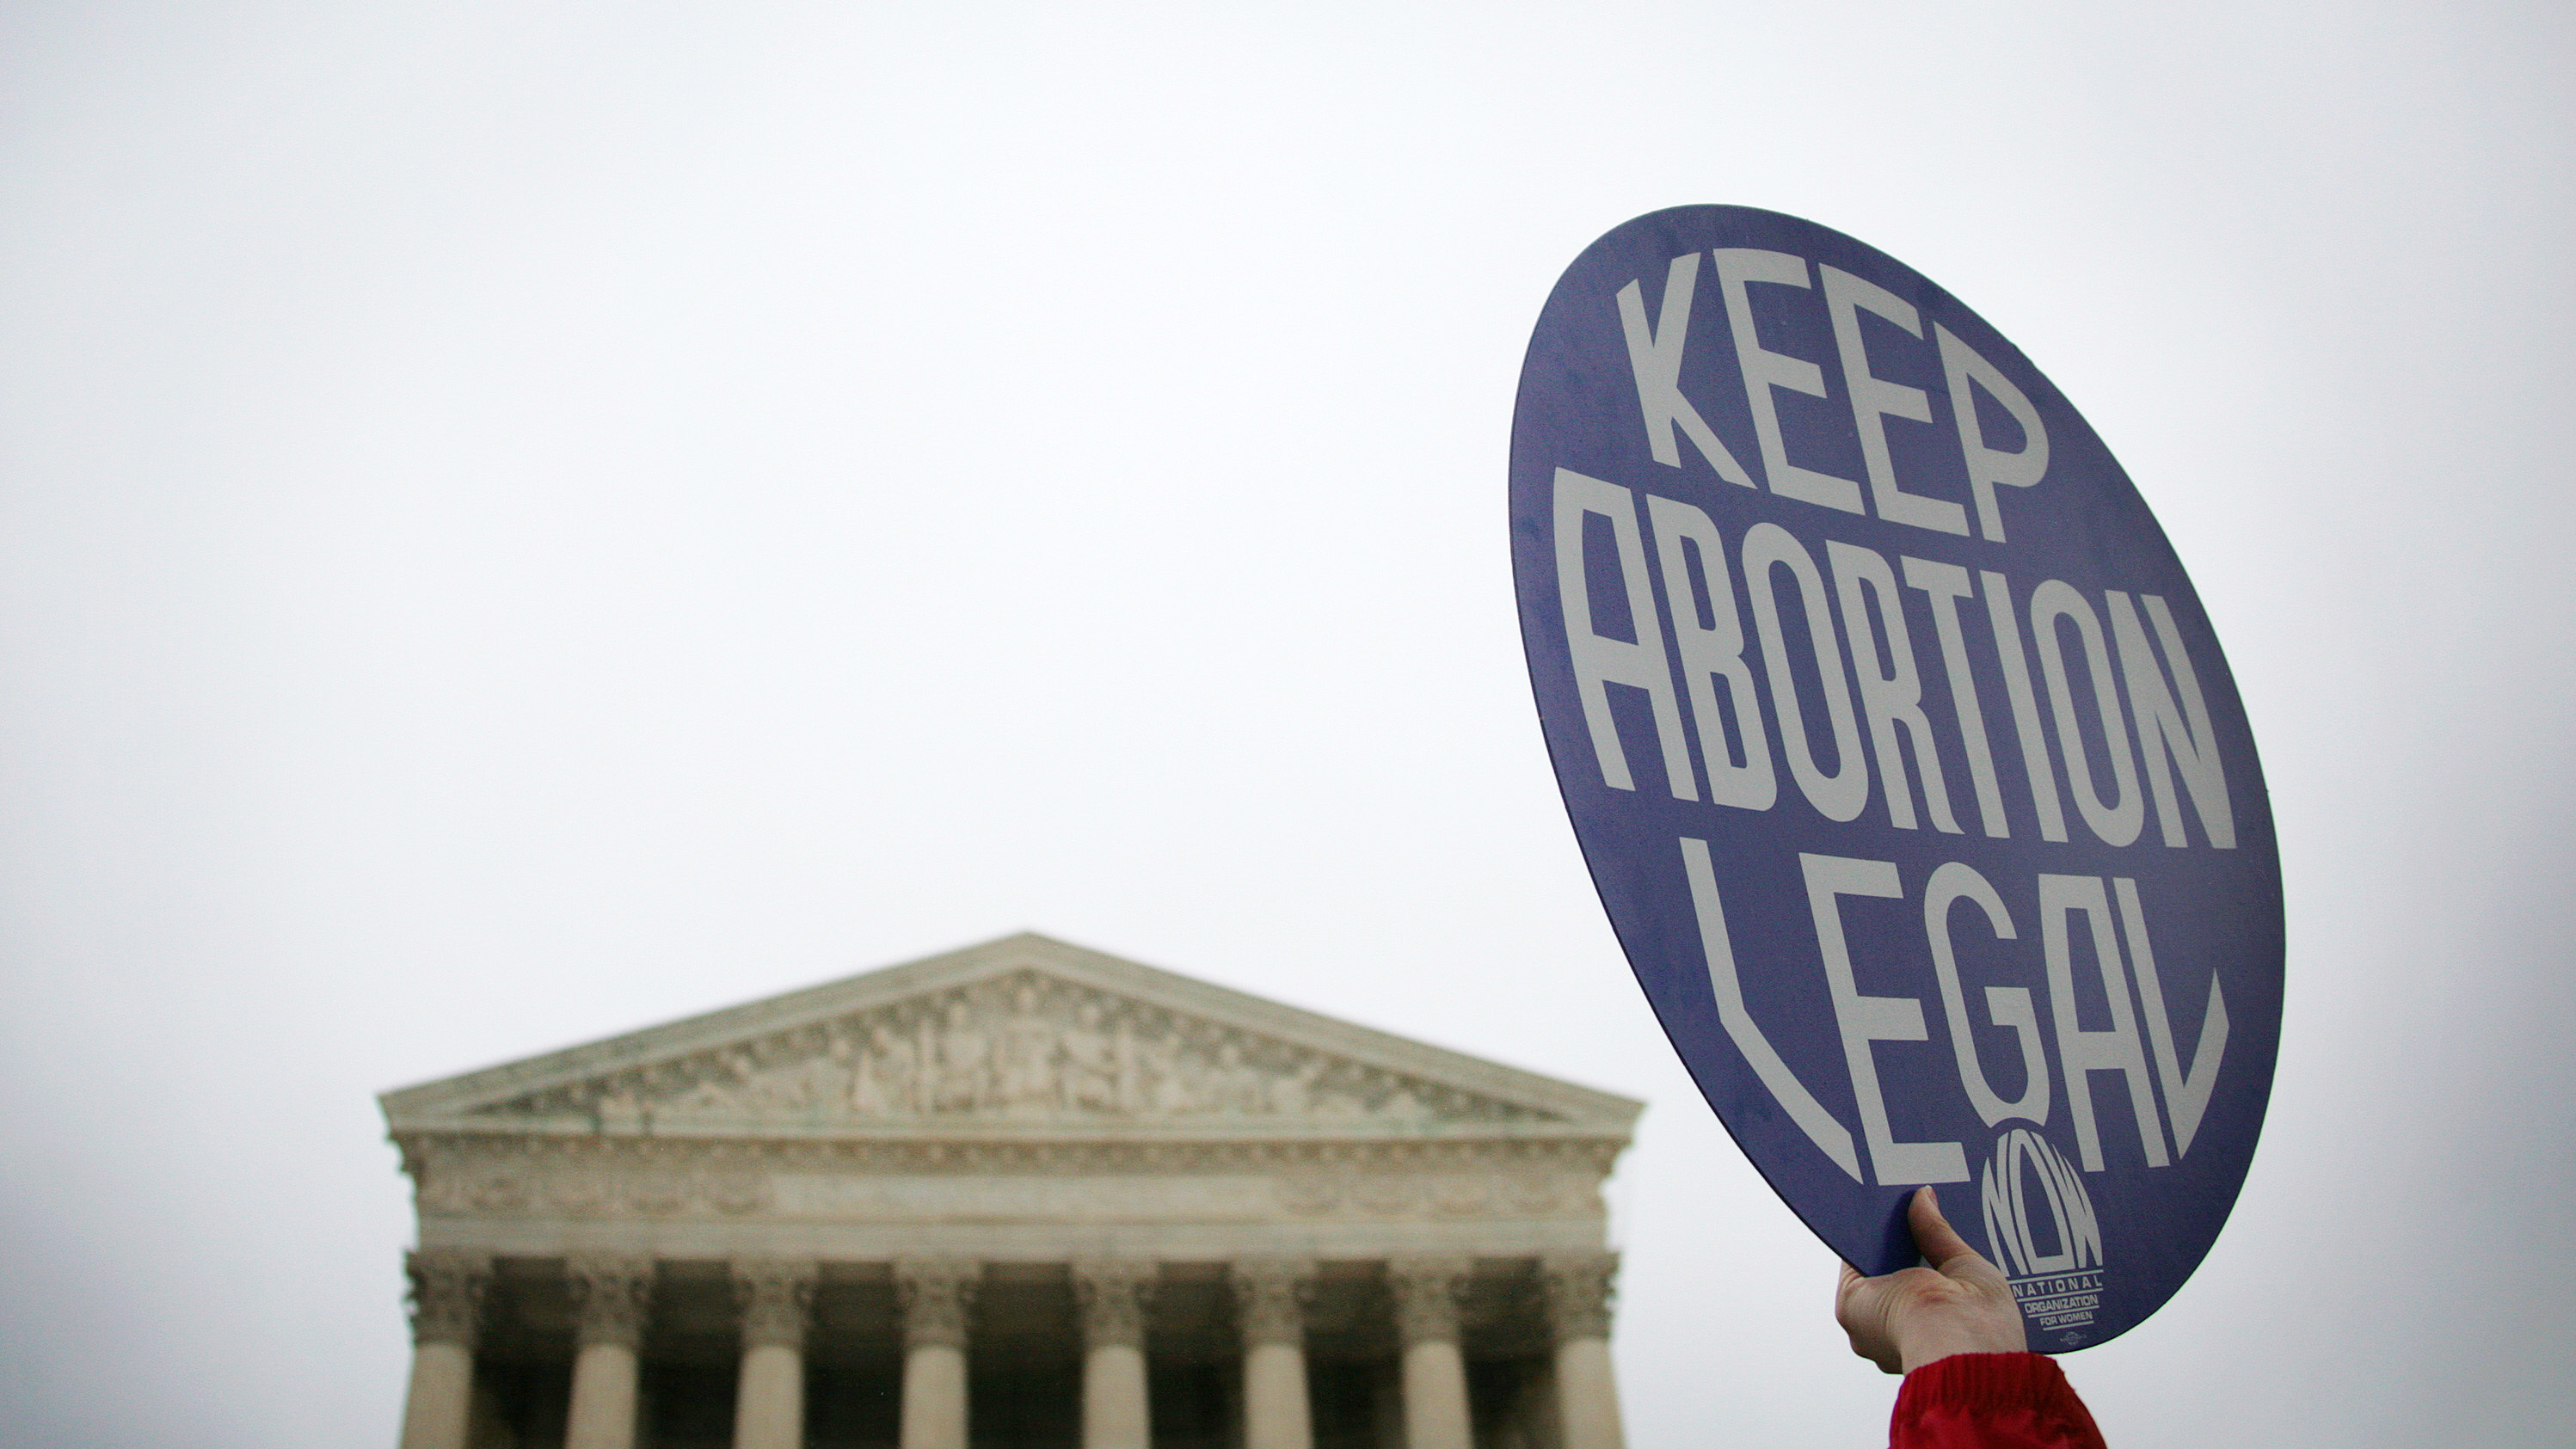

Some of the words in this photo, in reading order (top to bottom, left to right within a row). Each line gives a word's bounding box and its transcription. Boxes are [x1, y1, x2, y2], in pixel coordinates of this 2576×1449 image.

[1616, 248, 2050, 543] KEEP
[1553, 466, 2236, 850] ABORTION
[1679, 836, 2229, 1186] LEGAL
[1981, 1128, 2103, 1278] NOW
[2013, 1274, 2102, 1297] NATIONAL
[2025, 1294, 2099, 1313] ORGANIZATION
[2039, 1316, 2058, 1326] FOR
[2057, 1311, 2093, 1324] WOMEN
